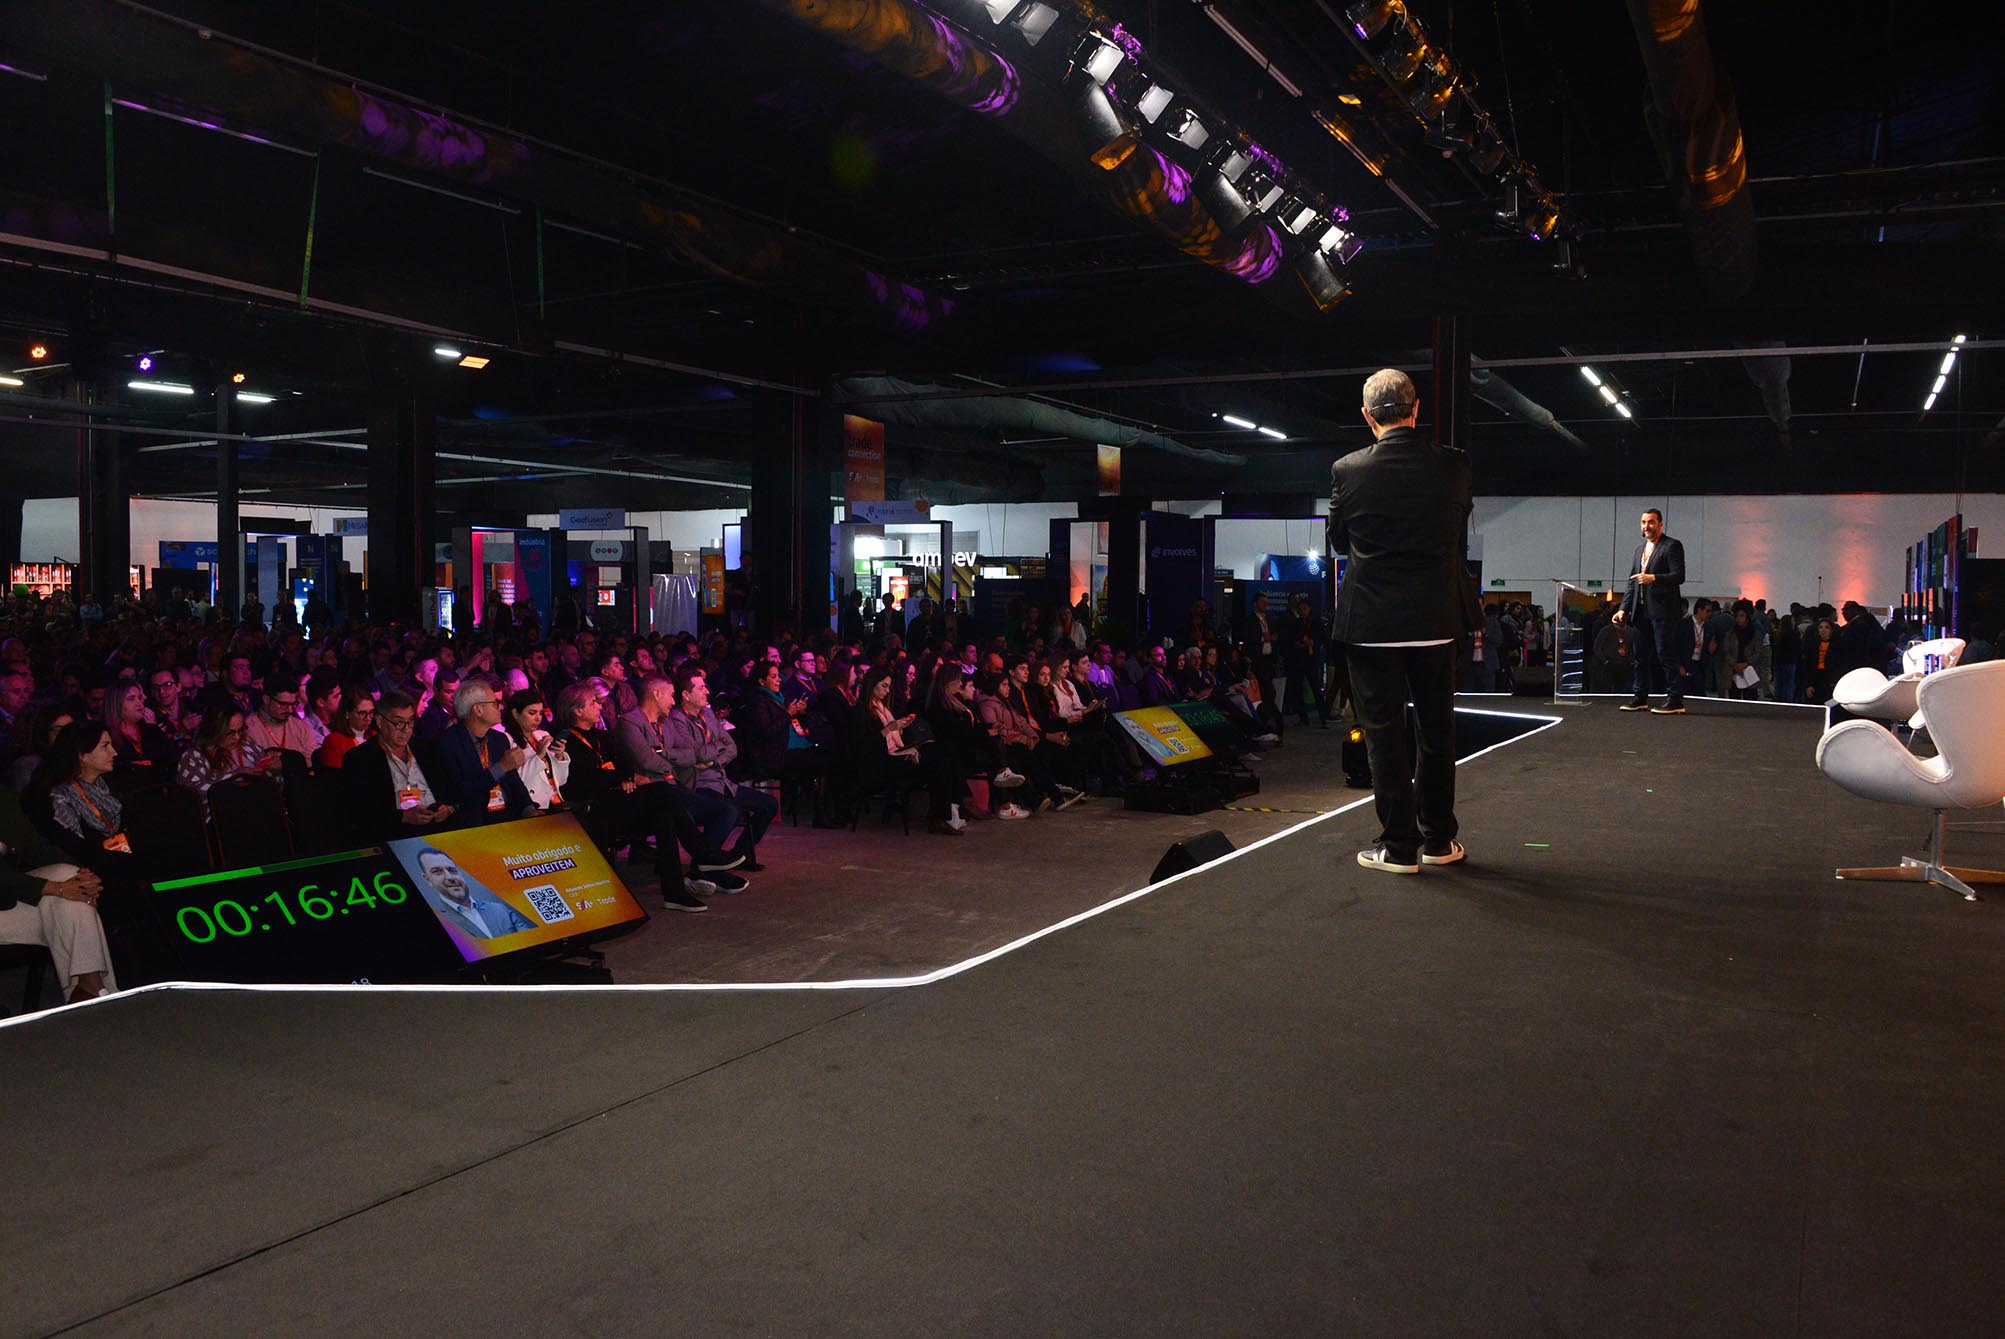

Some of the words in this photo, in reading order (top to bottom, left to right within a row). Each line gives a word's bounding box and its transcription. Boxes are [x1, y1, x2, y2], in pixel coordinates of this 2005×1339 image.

[912, 551, 977, 567] amev
[503, 854, 533, 867] Muito
[533, 845, 574, 859] obrigado
[575, 844, 582, 852] e
[512, 859, 575, 879] APROVEITEM
[176, 871, 407, 943] 00:16:46
